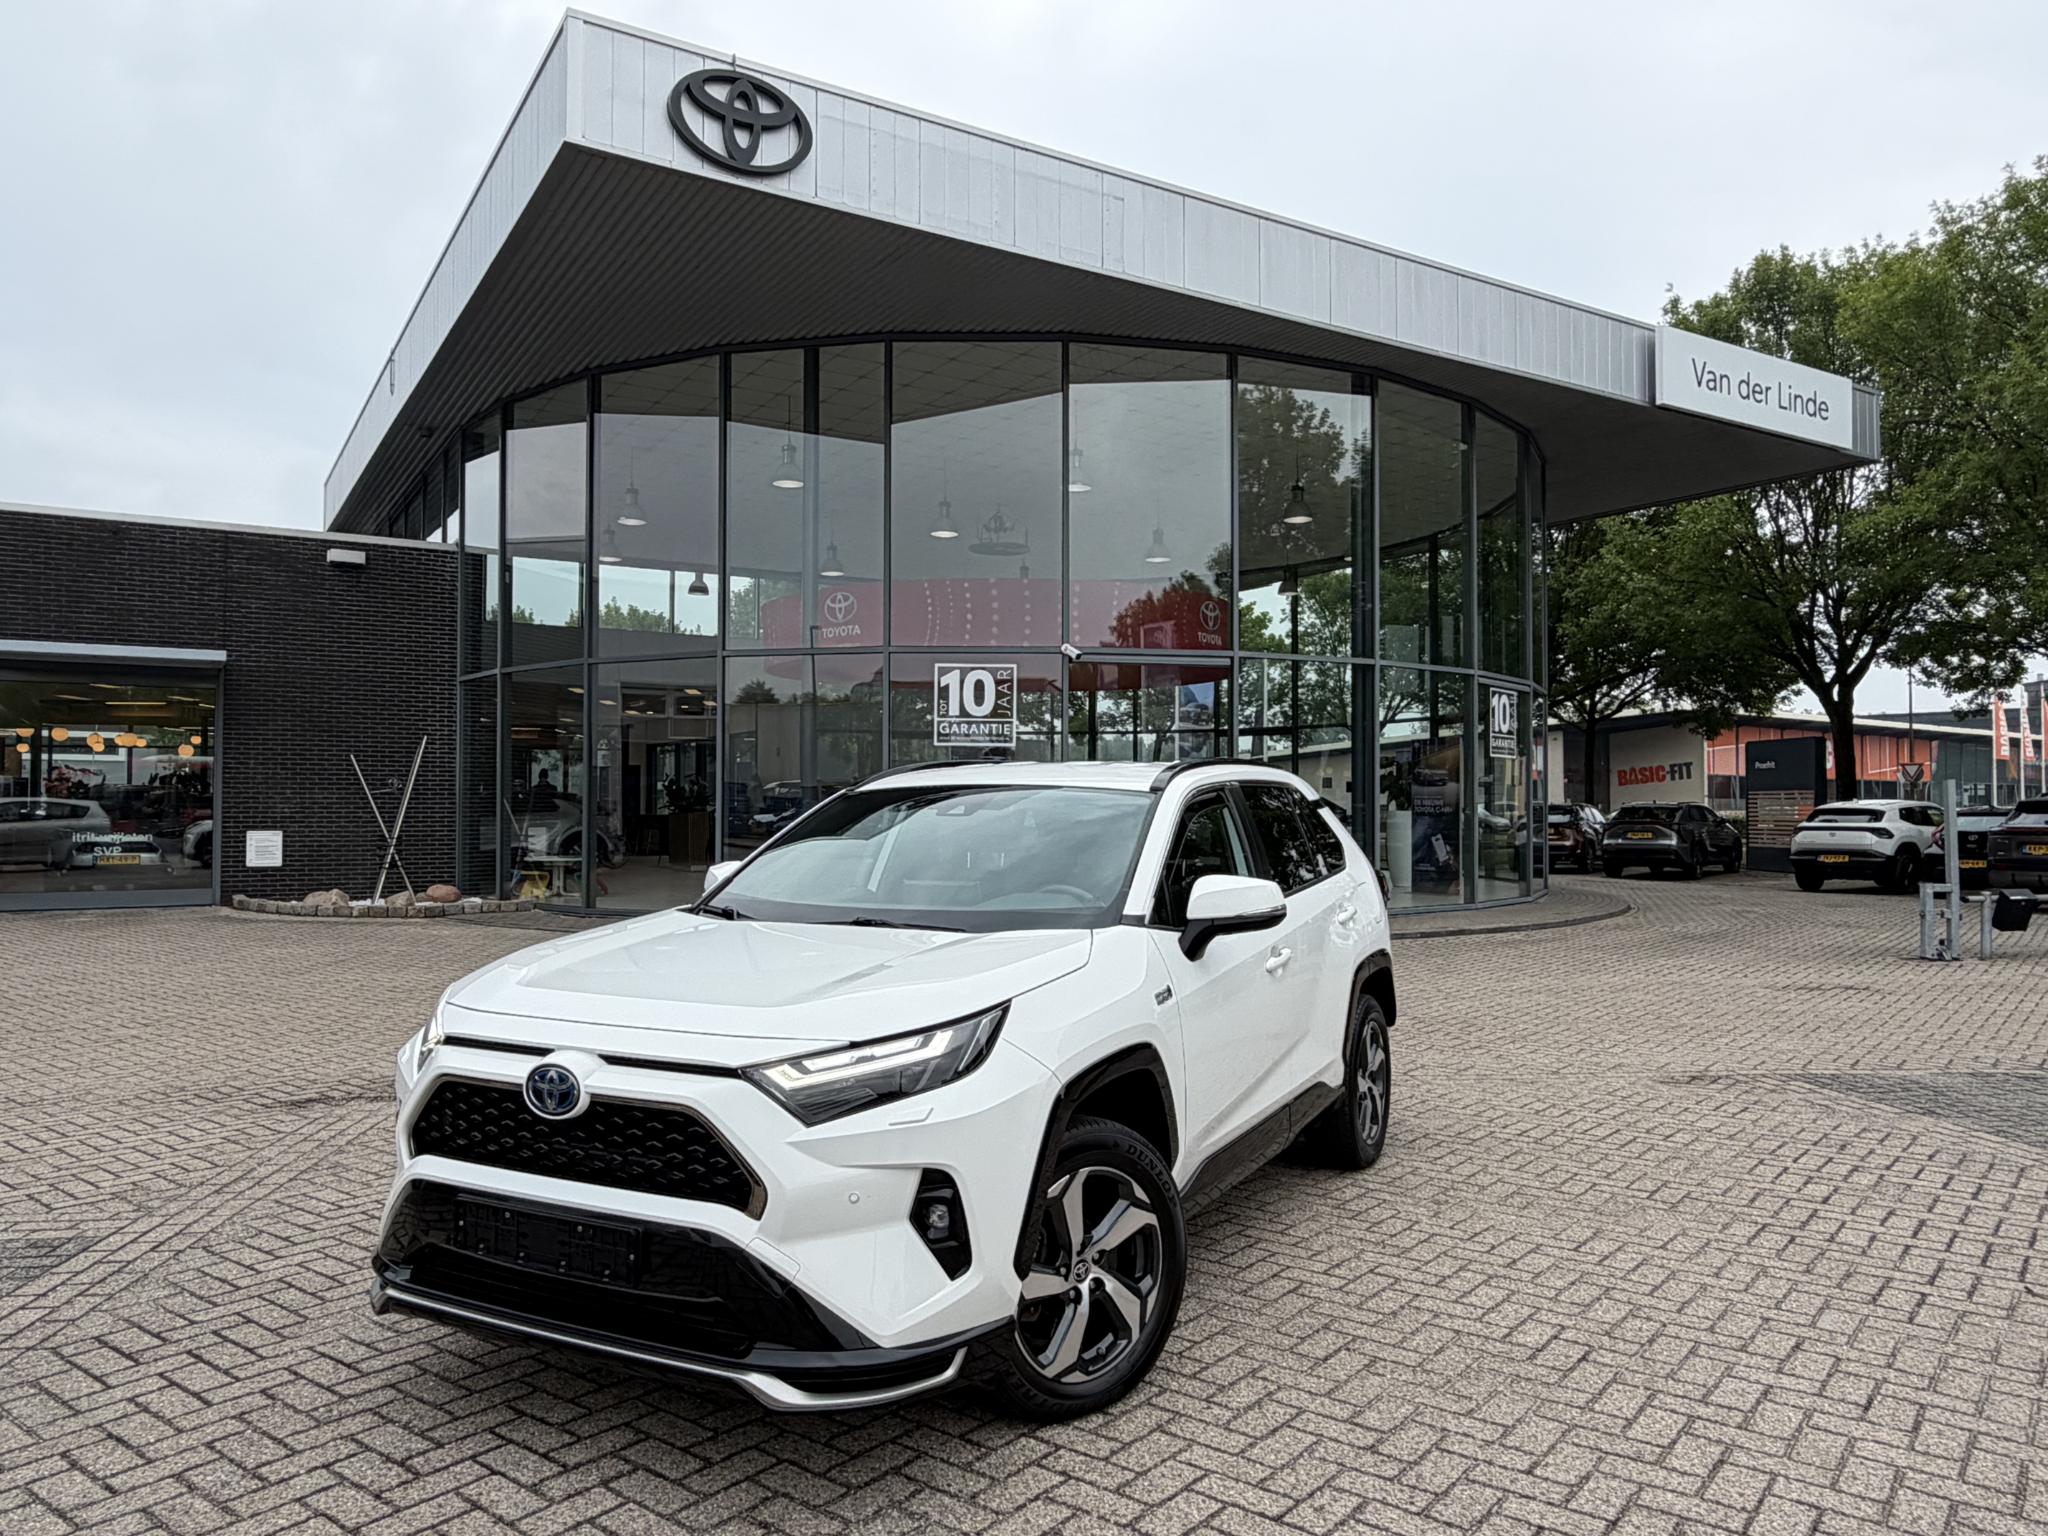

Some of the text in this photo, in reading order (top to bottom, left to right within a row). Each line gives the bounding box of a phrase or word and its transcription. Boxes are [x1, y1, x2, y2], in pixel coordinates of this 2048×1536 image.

[1692, 358, 1830, 421] Van der Linde
[822, 624, 861, 639] TOYOTA
[1197, 631, 1222, 646] TOYOTA
[939, 668, 996, 717] 10
[996, 669, 1012, 717] JAAR
[939, 699, 948, 716] TOT
[1492, 693, 1510, 734] 10
[939, 723, 1011, 734] GARANTIE
[1616, 761, 1694, 787] BASIC-FIT
